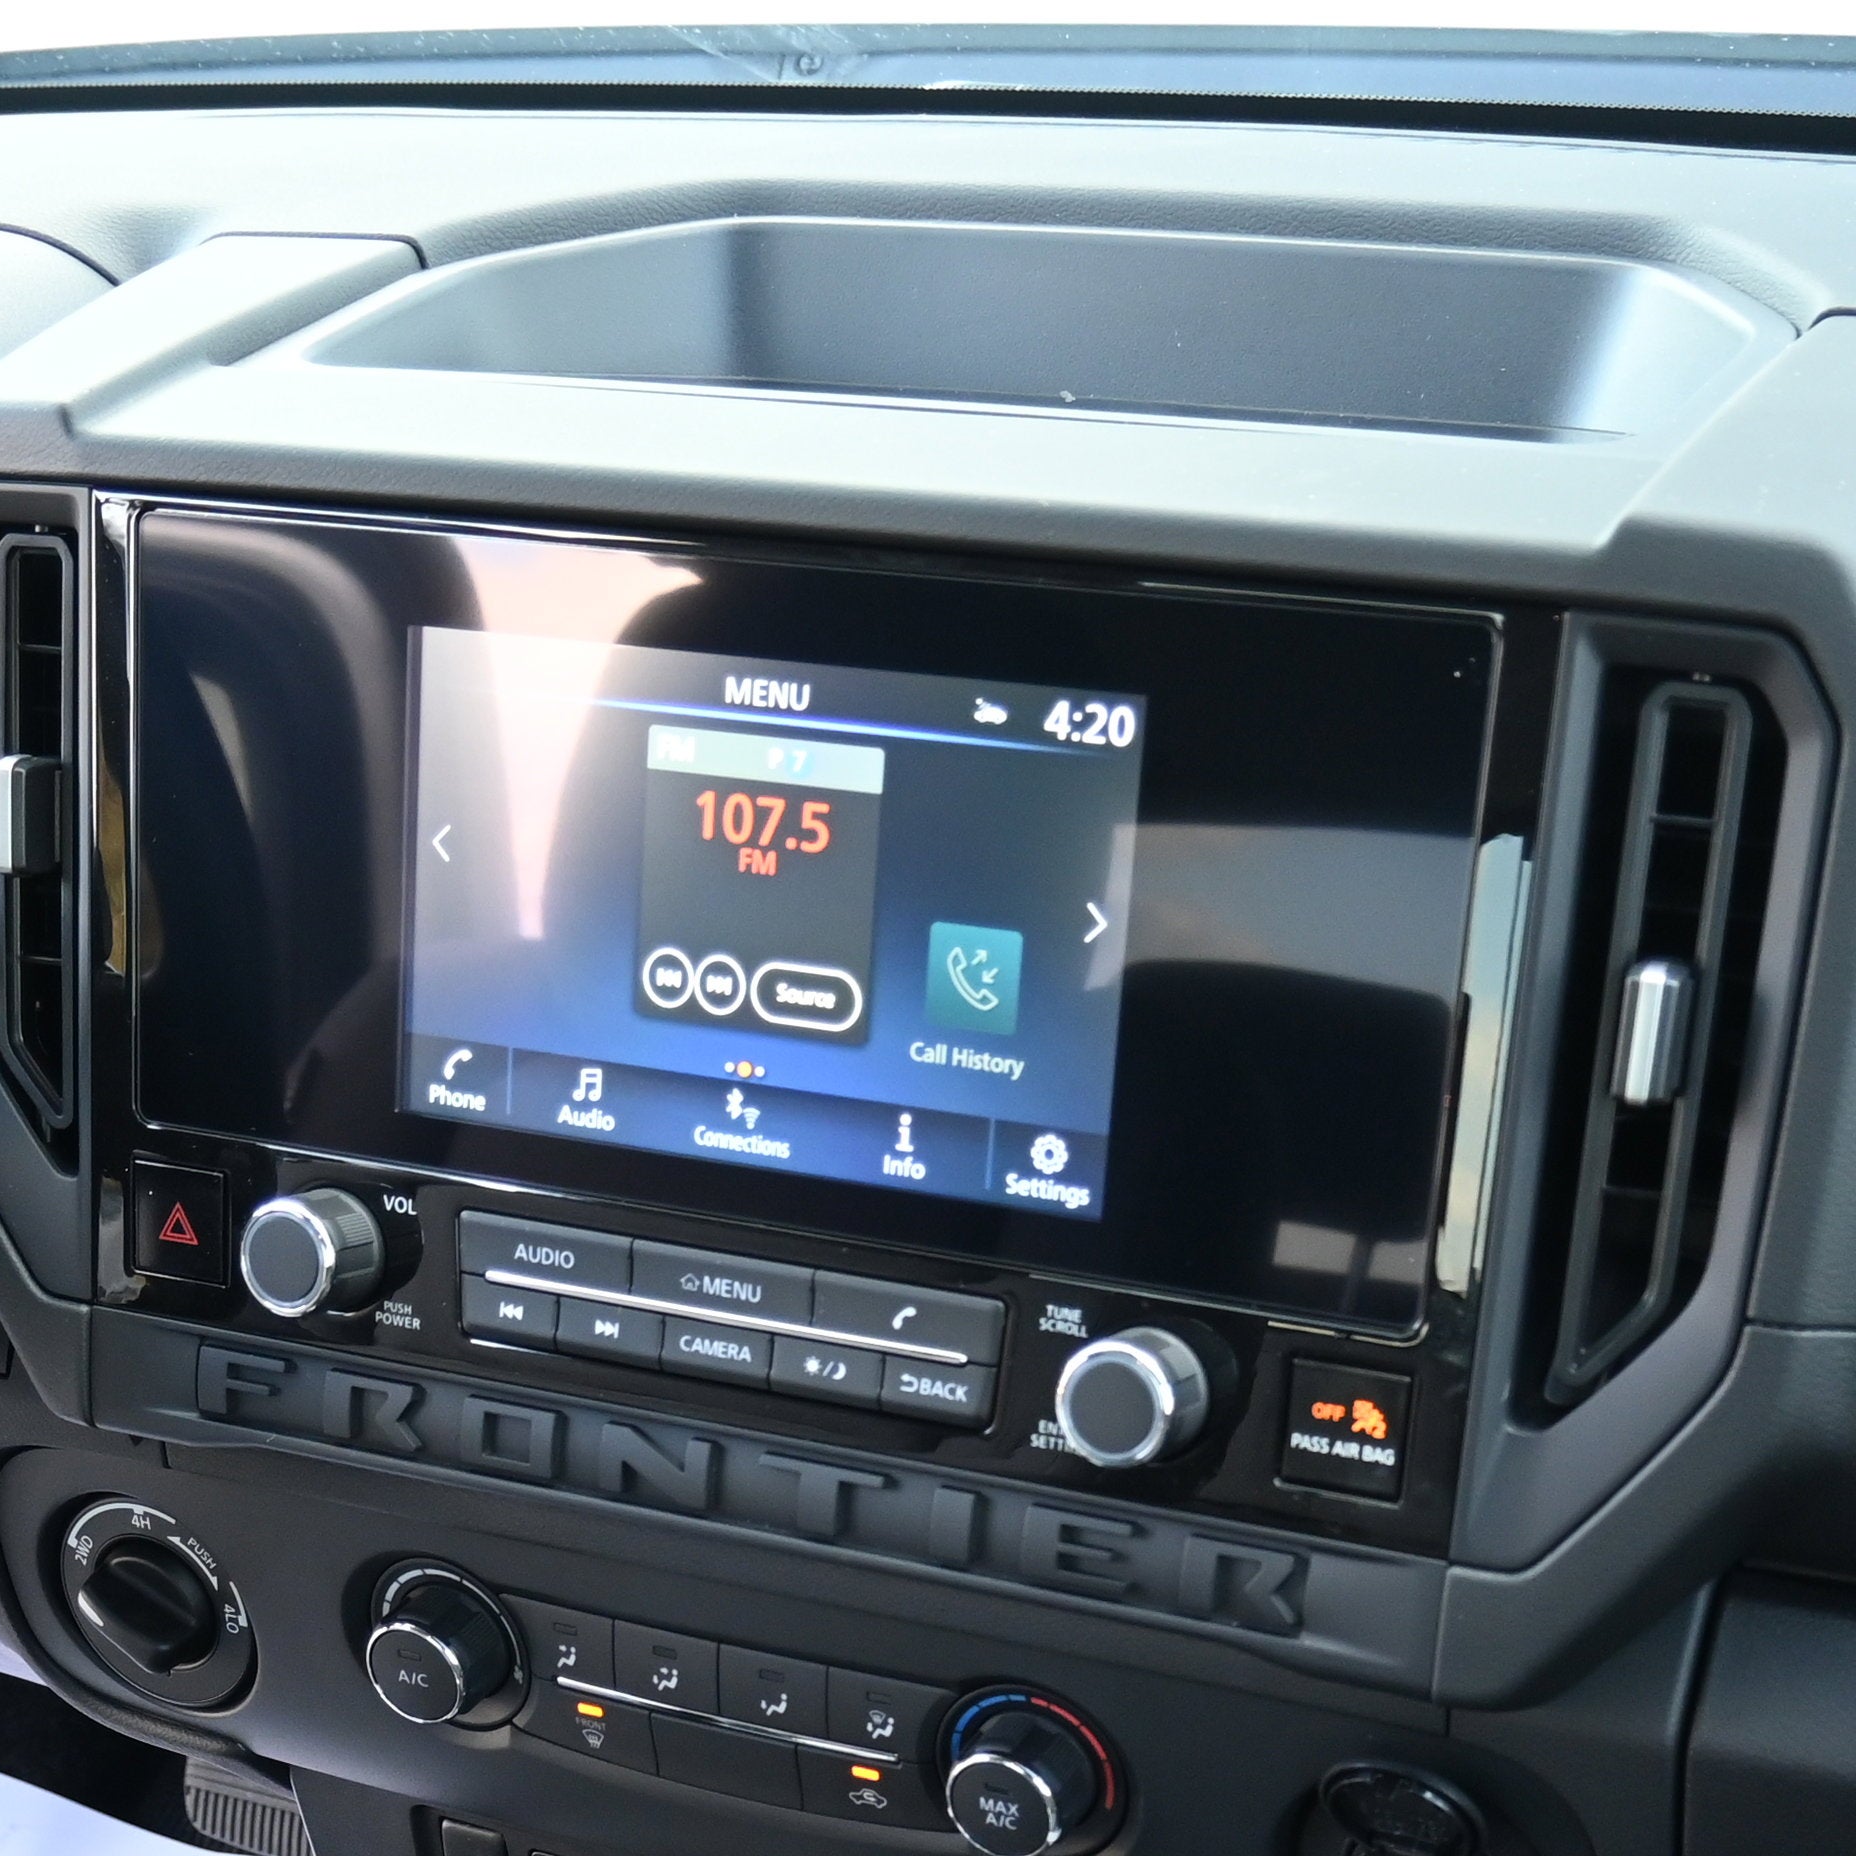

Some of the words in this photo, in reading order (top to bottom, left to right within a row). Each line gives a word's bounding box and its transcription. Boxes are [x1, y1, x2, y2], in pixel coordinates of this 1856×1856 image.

[724, 676, 811, 712] MENU
[1043, 699, 1137, 748] 4:20
[695, 789, 832, 855] 107.5
[737, 846, 778, 877] FM
[775, 982, 837, 1009] Source
[909, 1041, 948, 1067] Call
[952, 1047, 1025, 1080] History
[428, 1083, 486, 1112] Phone
[557, 1104, 615, 1132] Audio
[693, 1125, 791, 1160] Connections
[882, 1153, 927, 1181] Info
[383, 1194, 418, 1216] VOL
[1005, 1173, 1091, 1210] Settings
[513, 1242, 575, 1270] AUDIO
[702, 1275, 762, 1304] MENU
[374, 1311, 422, 1331] POWER
[383, 1300, 413, 1317] PUSH
[1046, 1304, 1083, 1323] TUNE
[1038, 1317, 1088, 1338] SCROLL
[679, 1334, 752, 1364] CAMERA
[918, 1377, 969, 1403] BACK
[1311, 1401, 1347, 1422] OFF
[1290, 1432, 1330, 1454] PASS
[1331, 1440, 1360, 1460] AIR
[1361, 1444, 1396, 1467] BAG
[196, 1342, 1312, 1638] FRONTIER
[131, 1514, 152, 1530] 4H
[74, 1534, 94, 1566] 2WD
[187, 1537, 217, 1570] PUSH
[223, 1603, 240, 1634] 4LO
[398, 1668, 430, 1688] A/C
[575, 1715, 608, 1732] FRONT
[979, 1796, 1020, 1818] MAX
[985, 1811, 1018, 1831] A/C
